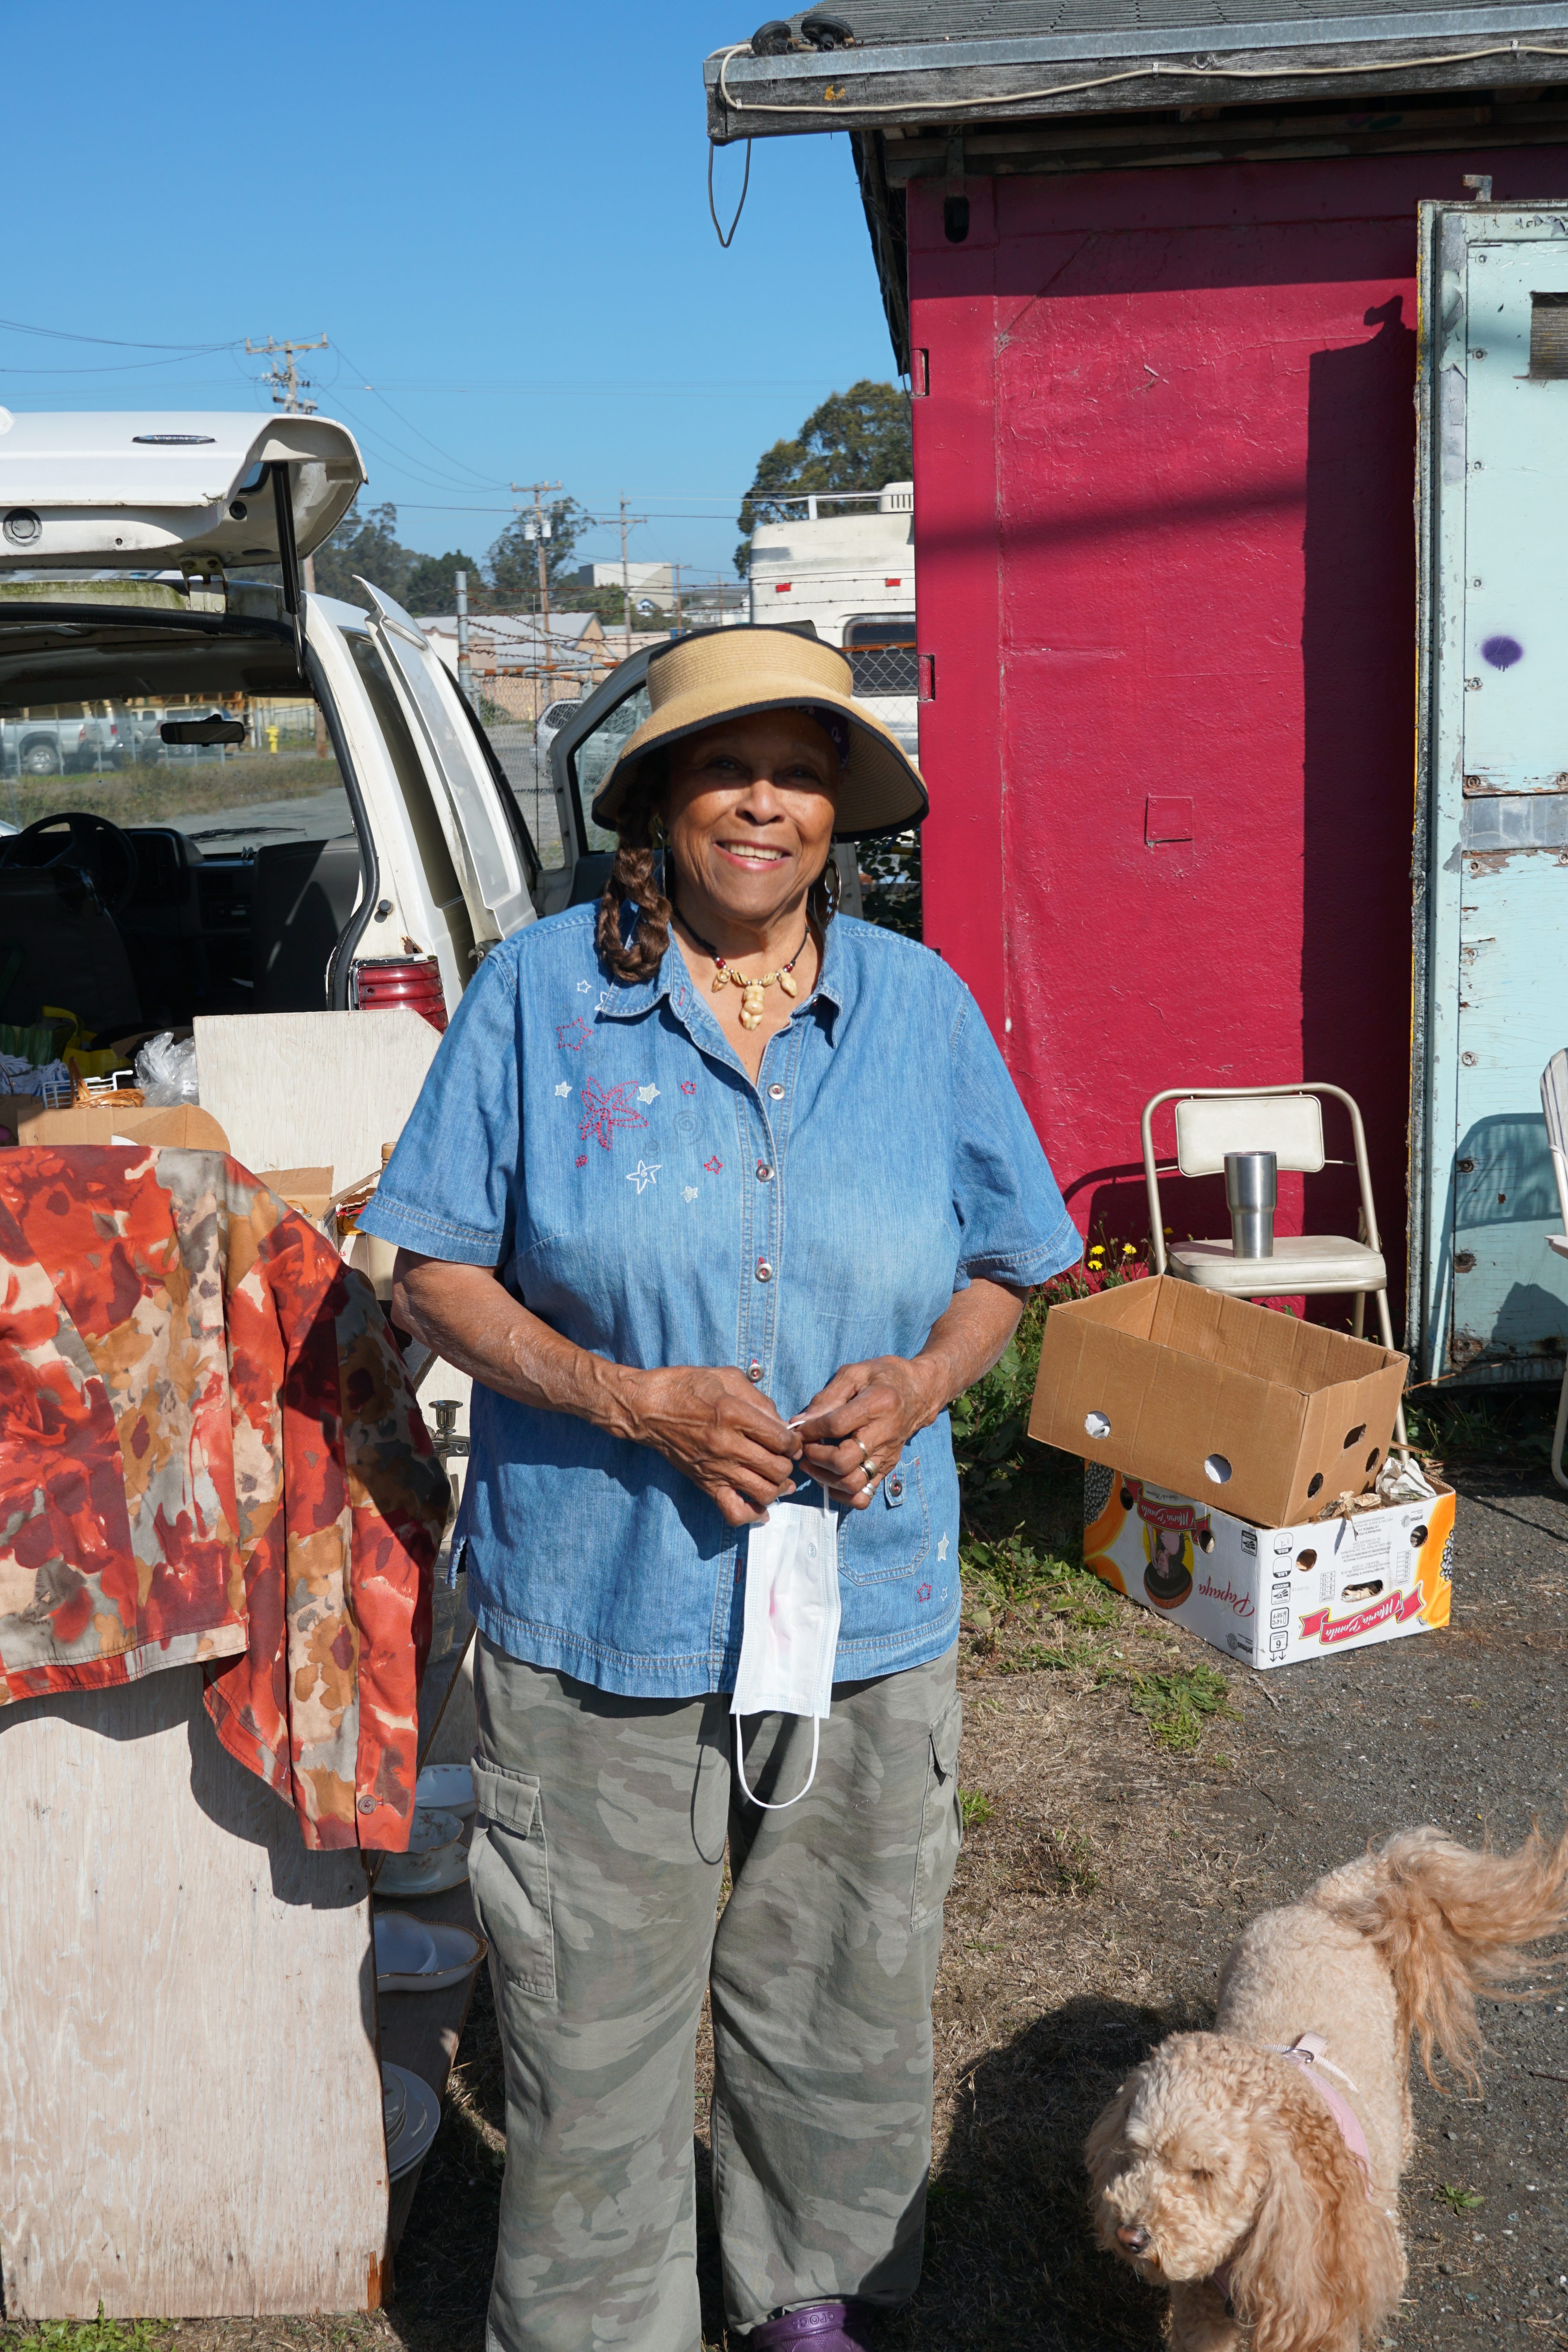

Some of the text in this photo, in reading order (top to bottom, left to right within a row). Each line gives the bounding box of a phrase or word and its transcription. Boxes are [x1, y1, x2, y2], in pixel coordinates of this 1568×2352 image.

[1141, 1504, 1167, 1524] Bonita
[1198, 1575, 1254, 1617] Papaya
[1237, 1642, 1253, 1654] primus
[1276, 1640, 1281, 1649] 6
[792, 2312, 835, 2329] crocs
